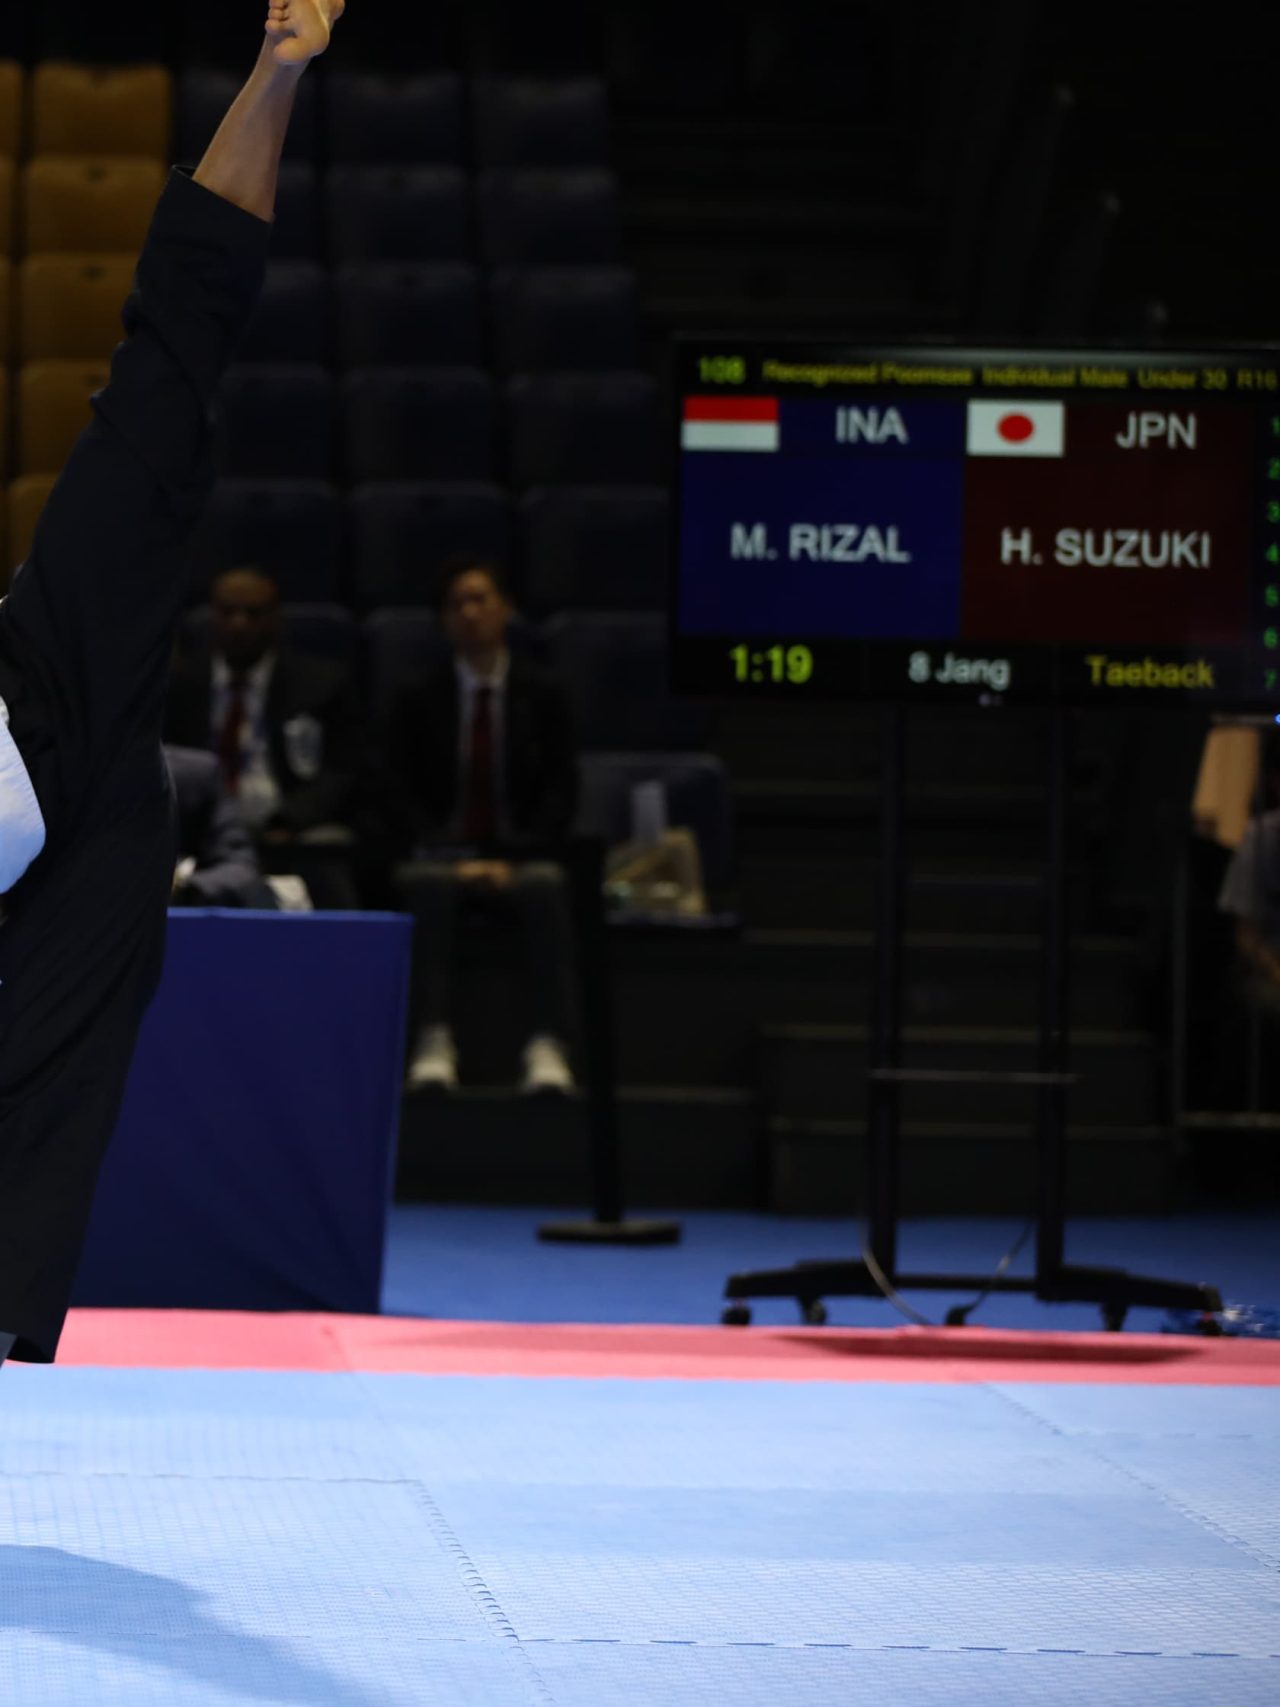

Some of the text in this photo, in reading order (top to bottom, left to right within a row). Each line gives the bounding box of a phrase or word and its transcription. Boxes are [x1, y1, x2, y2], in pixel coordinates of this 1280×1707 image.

[835, 406, 909, 444] INA
[1115, 411, 1197, 449] JPN
[730, 522, 912, 564] M. RIZAL
[1000, 526, 1210, 569] H. SUZUKI
[730, 644, 813, 684] 1:19
[908, 650, 1011, 691] 8 Jang
[1085, 655, 1215, 689] Taeback
